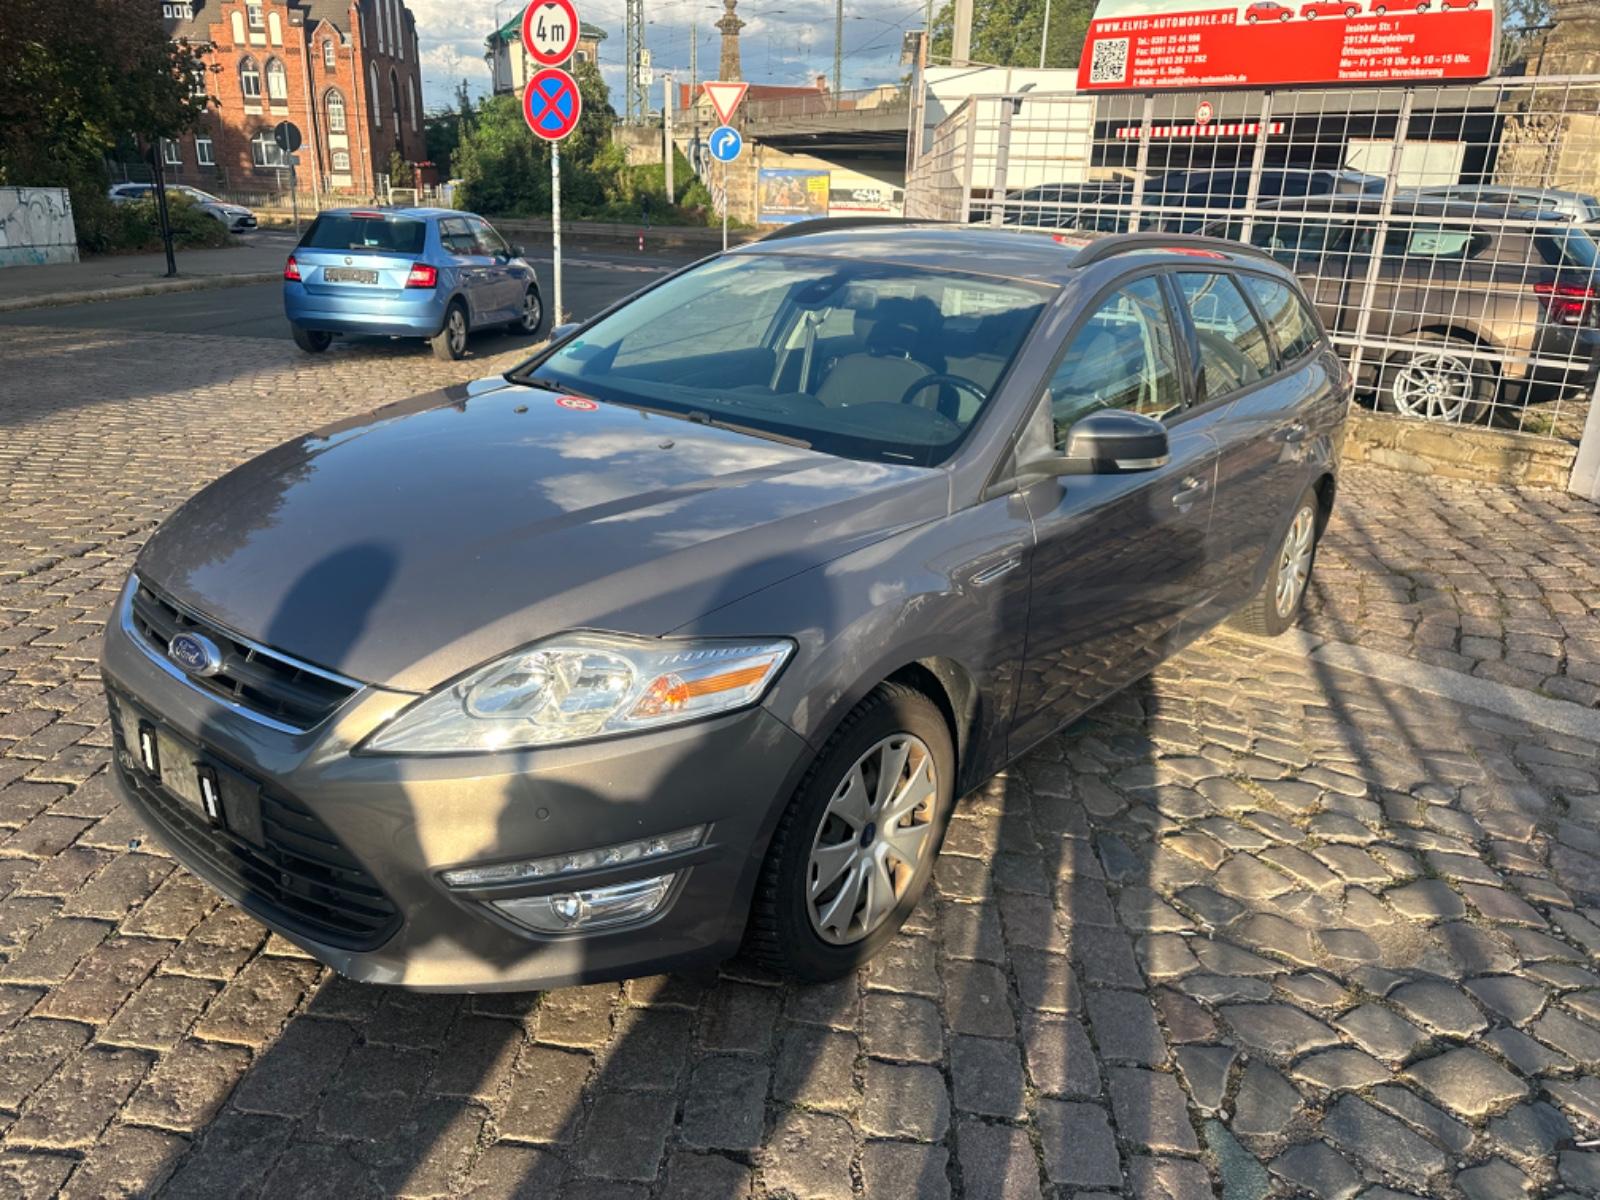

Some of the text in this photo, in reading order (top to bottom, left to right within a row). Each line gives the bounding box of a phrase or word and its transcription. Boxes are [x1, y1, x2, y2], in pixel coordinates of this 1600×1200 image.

[536, 15, 564, 42] 4 m
[1096, 13, 1235, 33] WWW.ELVIS-AUTOMOBILE.DE
[1394, 21, 1400, 31] 1
[1370, 33, 1415, 44] Magdeburg
[1394, 56, 1409, 66] Uhr
[1369, 69, 1389, 78] nach
[1391, 68, 1444, 78] Vereinbarung
[176, 639, 200, 664] Ford
